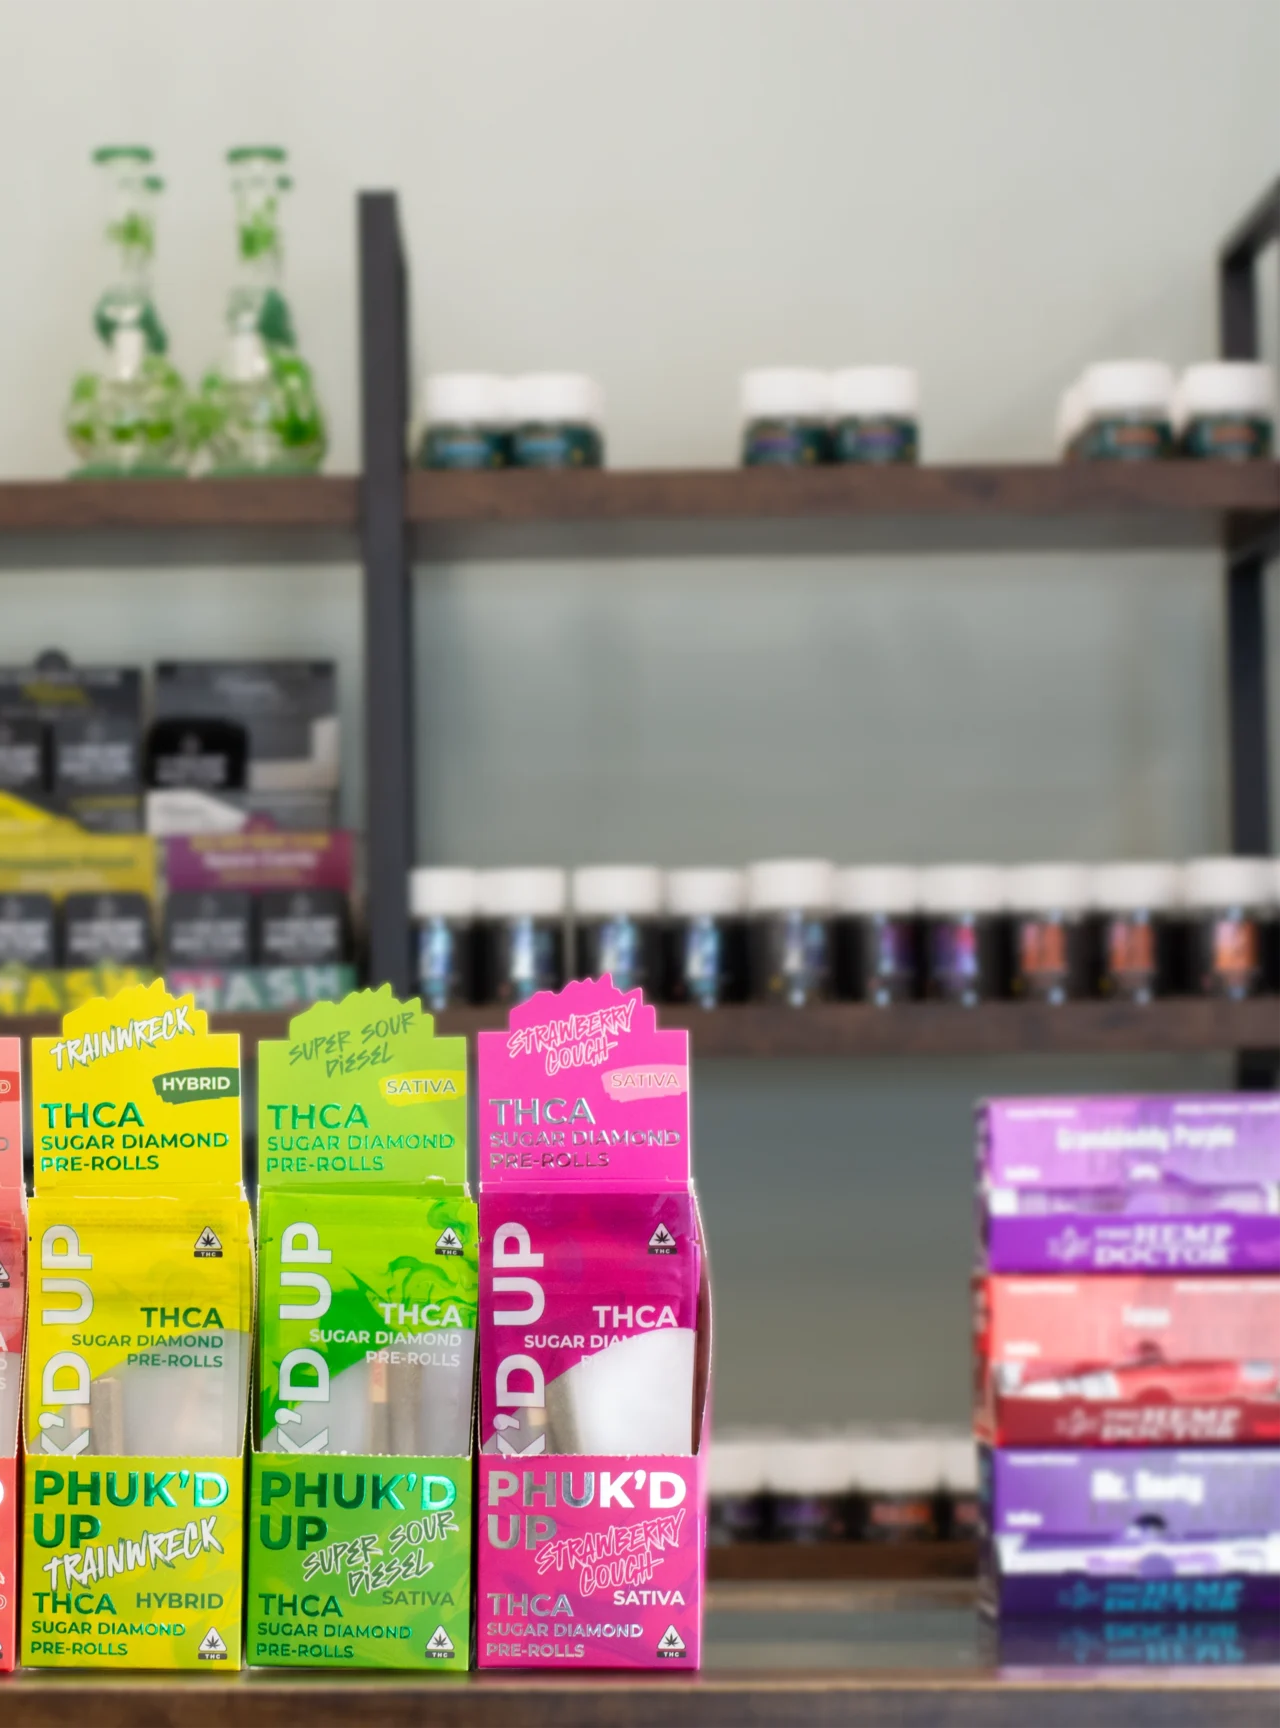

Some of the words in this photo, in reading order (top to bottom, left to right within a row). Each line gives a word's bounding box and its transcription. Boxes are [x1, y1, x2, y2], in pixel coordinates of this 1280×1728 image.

[50, 1005, 195, 1071] TRAINWRECK
[288, 1030, 353, 1066] SUPER
[360, 1011, 417, 1044] SOUR
[506, 998, 637, 1058] STRAWBERRY
[545, 1034, 618, 1077] COUGH
[162, 1076, 230, 1091] HYBRID
[386, 1079, 456, 1094] SATIVA
[611, 1073, 679, 1088] SATIVA
[40, 1101, 145, 1129] THCA
[267, 1103, 370, 1130] THCA
[489, 1097, 596, 1126] THCA
[41, 1134, 115, 1151] SUGAR
[122, 1132, 229, 1149] DIAMOND
[267, 1135, 341, 1152] SUGAR
[348, 1133, 455, 1149] DIAMOND
[489, 1130, 565, 1148] SUGAR
[572, 1129, 681, 1147] DIAMOND
[40, 1155, 159, 1172] PRE-ROLLS
[267, 1155, 385, 1173] PRE-ROLLS
[490, 1152, 609, 1169] PRE-ROLLS
[41, 1224, 94, 1326] UP
[279, 1222, 332, 1320] UP
[492, 1221, 545, 1326] UP
[140, 1307, 224, 1329] THCA
[379, 1302, 463, 1327] THCA
[593, 1305, 678, 1328] THCA
[71, 1334, 131, 1347] SUGAR
[137, 1335, 224, 1349] DIAMOND
[309, 1329, 370, 1344] SUGAR
[376, 1331, 462, 1347] DIAMOND
[524, 1335, 585, 1348] SUGAR
[127, 1353, 223, 1368] PRE-ROLLS
[366, 1350, 460, 1367] PRE-ROLLS
[34, 1469, 229, 1508] PHUK'D
[261, 1471, 457, 1511] PHUK'D
[488, 1469, 687, 1509] PHUK'D
[33, 1513, 102, 1549] UP
[259, 1514, 328, 1551] UP
[487, 1514, 557, 1550] UP
[535, 1508, 686, 1575] STRAWBERRY
[42, 1515, 225, 1591] TRAINWRECK
[302, 1534, 383, 1582] SUPER
[388, 1510, 460, 1555] SOUR
[579, 1551, 665, 1597] COUGH
[32, 1592, 117, 1615] THCA
[136, 1592, 224, 1609] HYBRID
[258, 1593, 344, 1618] THCA
[382, 1590, 455, 1606] SATIVA
[487, 1593, 574, 1617] THCA
[613, 1590, 686, 1606] SATIVA
[31, 1620, 92, 1635] SUGAR
[98, 1622, 186, 1636] DIAMOND
[257, 1622, 318, 1638] SUGAR
[324, 1624, 413, 1639] DIAMOND
[486, 1622, 549, 1637] SUGAR
[554, 1624, 644, 1638] DIAMOND
[31, 1641, 128, 1656] PRE-ROLLS
[256, 1643, 355, 1658] PRE-ROLLS
[486, 1643, 585, 1658] PRE-ROLLS
